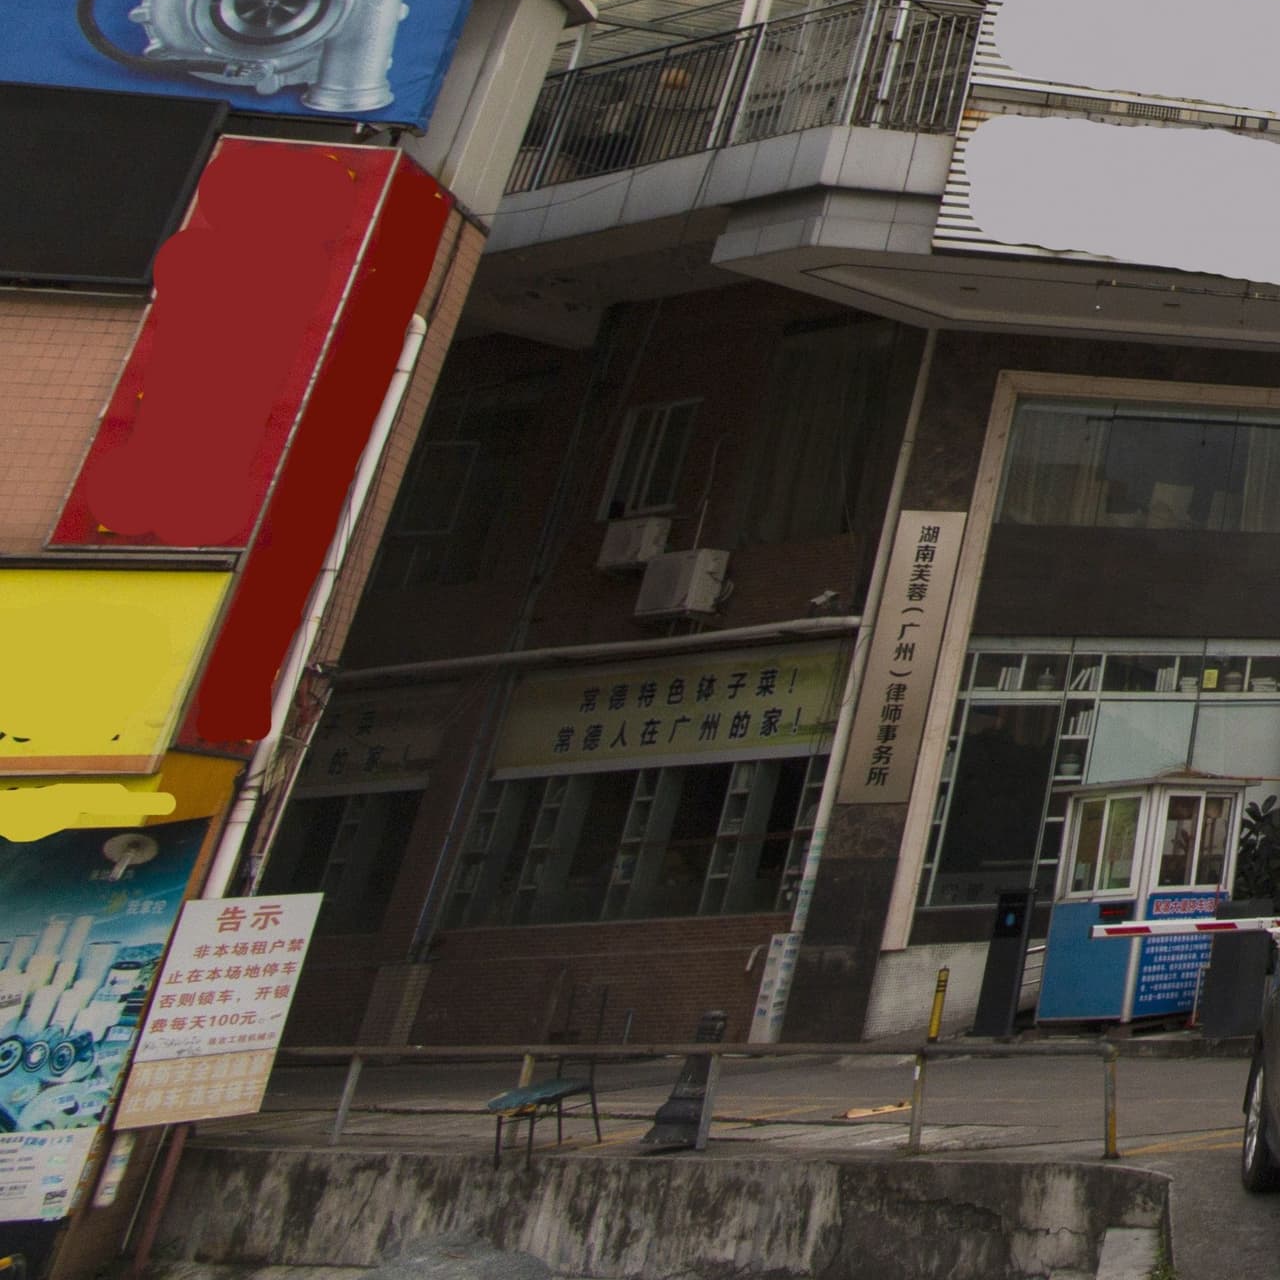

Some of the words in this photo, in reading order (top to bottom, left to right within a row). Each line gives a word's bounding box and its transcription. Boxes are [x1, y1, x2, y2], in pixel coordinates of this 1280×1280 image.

[865, 526, 940, 787] 湖南芙蓉（广州）律师事务所
[552, 707, 802, 754] 常德人在广州的家！
[217, 904, 283, 933] 告示
[193, 938, 305, 959] 非本场租户禁
[166, 961, 298, 985] 止在本场地停车
